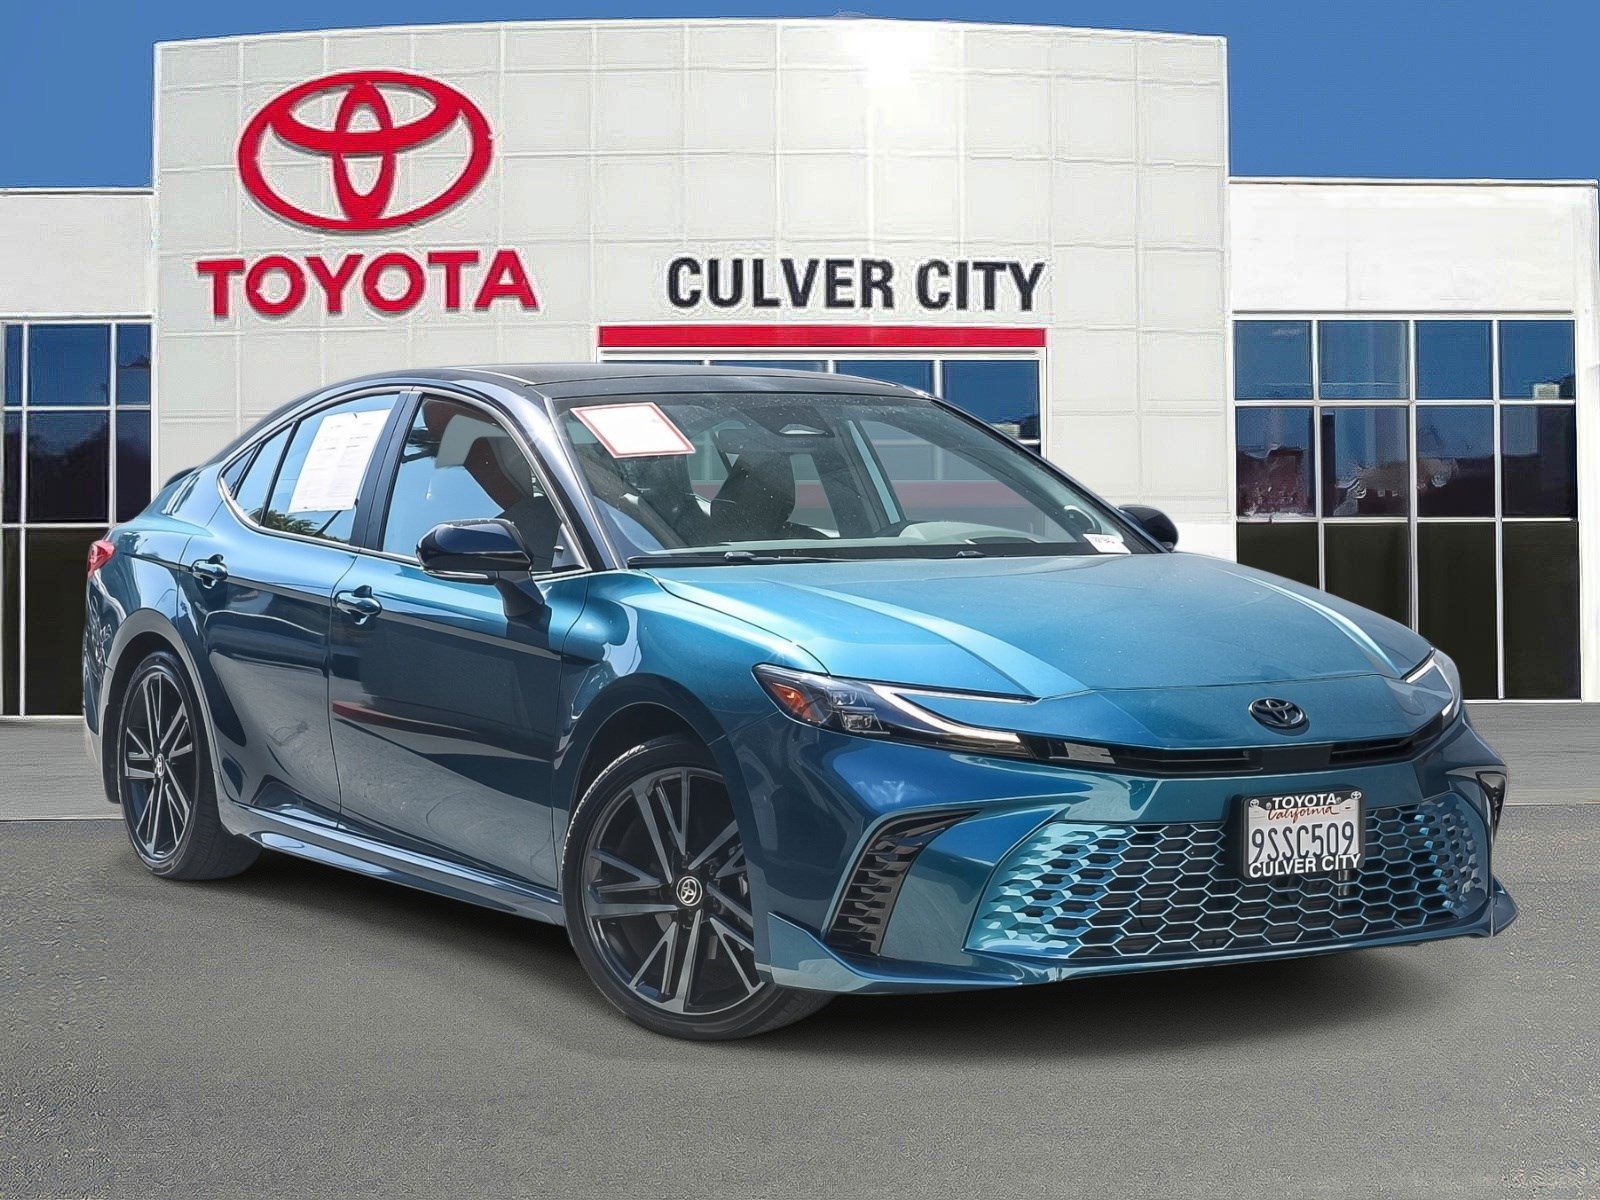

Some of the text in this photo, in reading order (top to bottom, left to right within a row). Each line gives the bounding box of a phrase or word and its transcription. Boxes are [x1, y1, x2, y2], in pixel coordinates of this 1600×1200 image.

[195, 249, 540, 319] TOYOTA
[667, 257, 1046, 311] CULVER CITY
[1267, 806, 1340, 824] California
[1272, 793, 1337, 810] TOYOTA
[1251, 821, 1354, 863] 9SSC509
[1249, 853, 1361, 878] CULVER CITY
